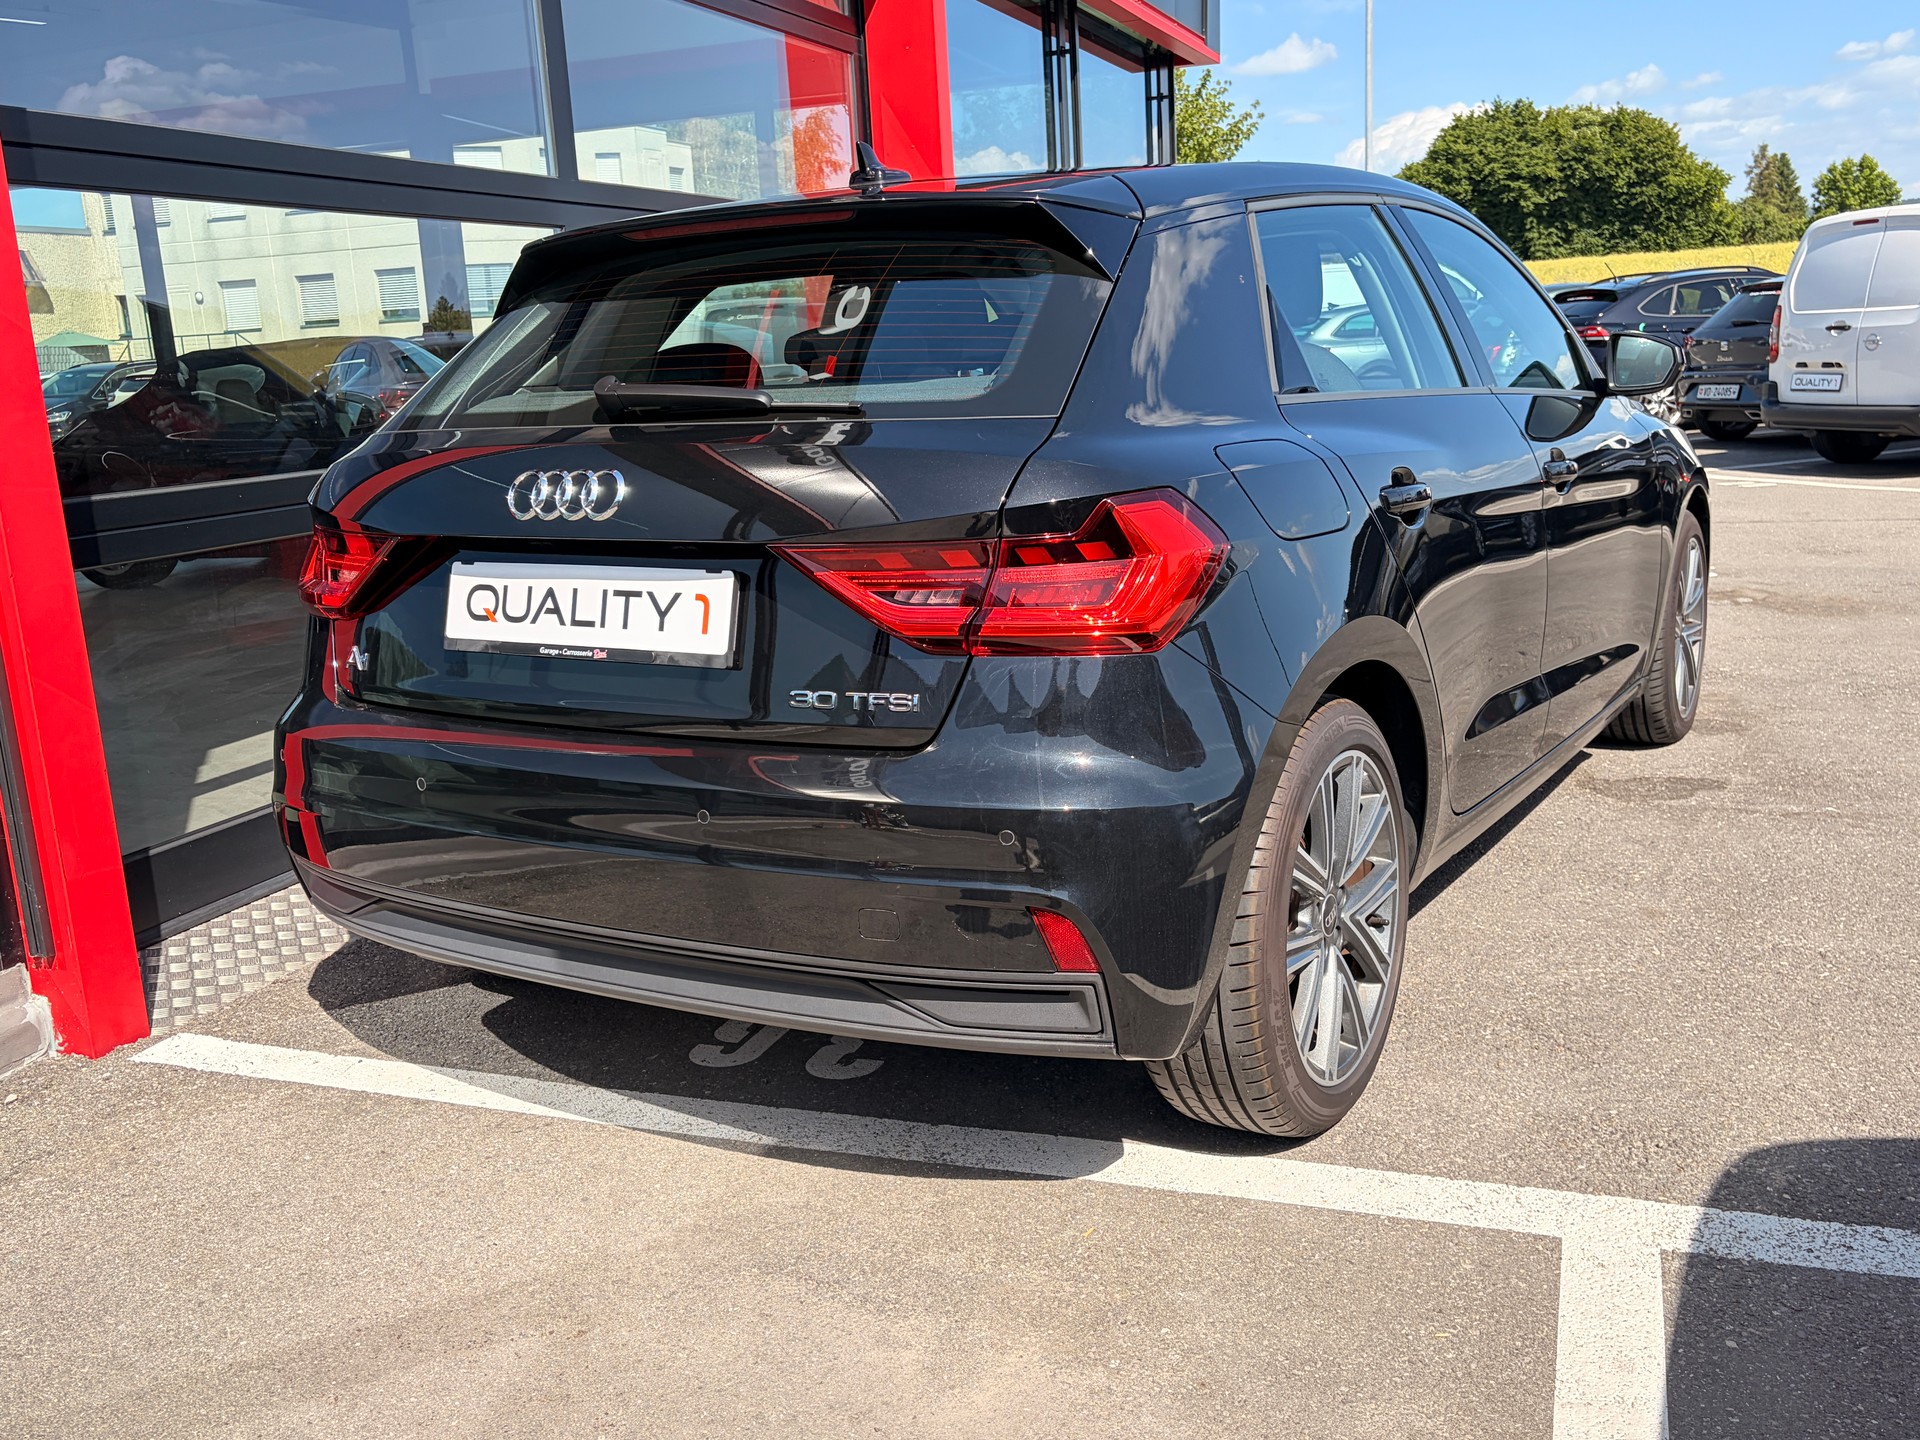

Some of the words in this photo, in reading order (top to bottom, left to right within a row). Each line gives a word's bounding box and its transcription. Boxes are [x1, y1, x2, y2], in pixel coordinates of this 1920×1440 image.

[1794, 377, 1833, 387] QUALITY
[466, 583, 682, 632] QUALITY
[695, 593, 710, 635] 1
[540, 646, 560, 656] Garage
[563, 648, 593, 657] Carrosserie
[788, 690, 838, 709] 30
[845, 692, 920, 712] TFSI
